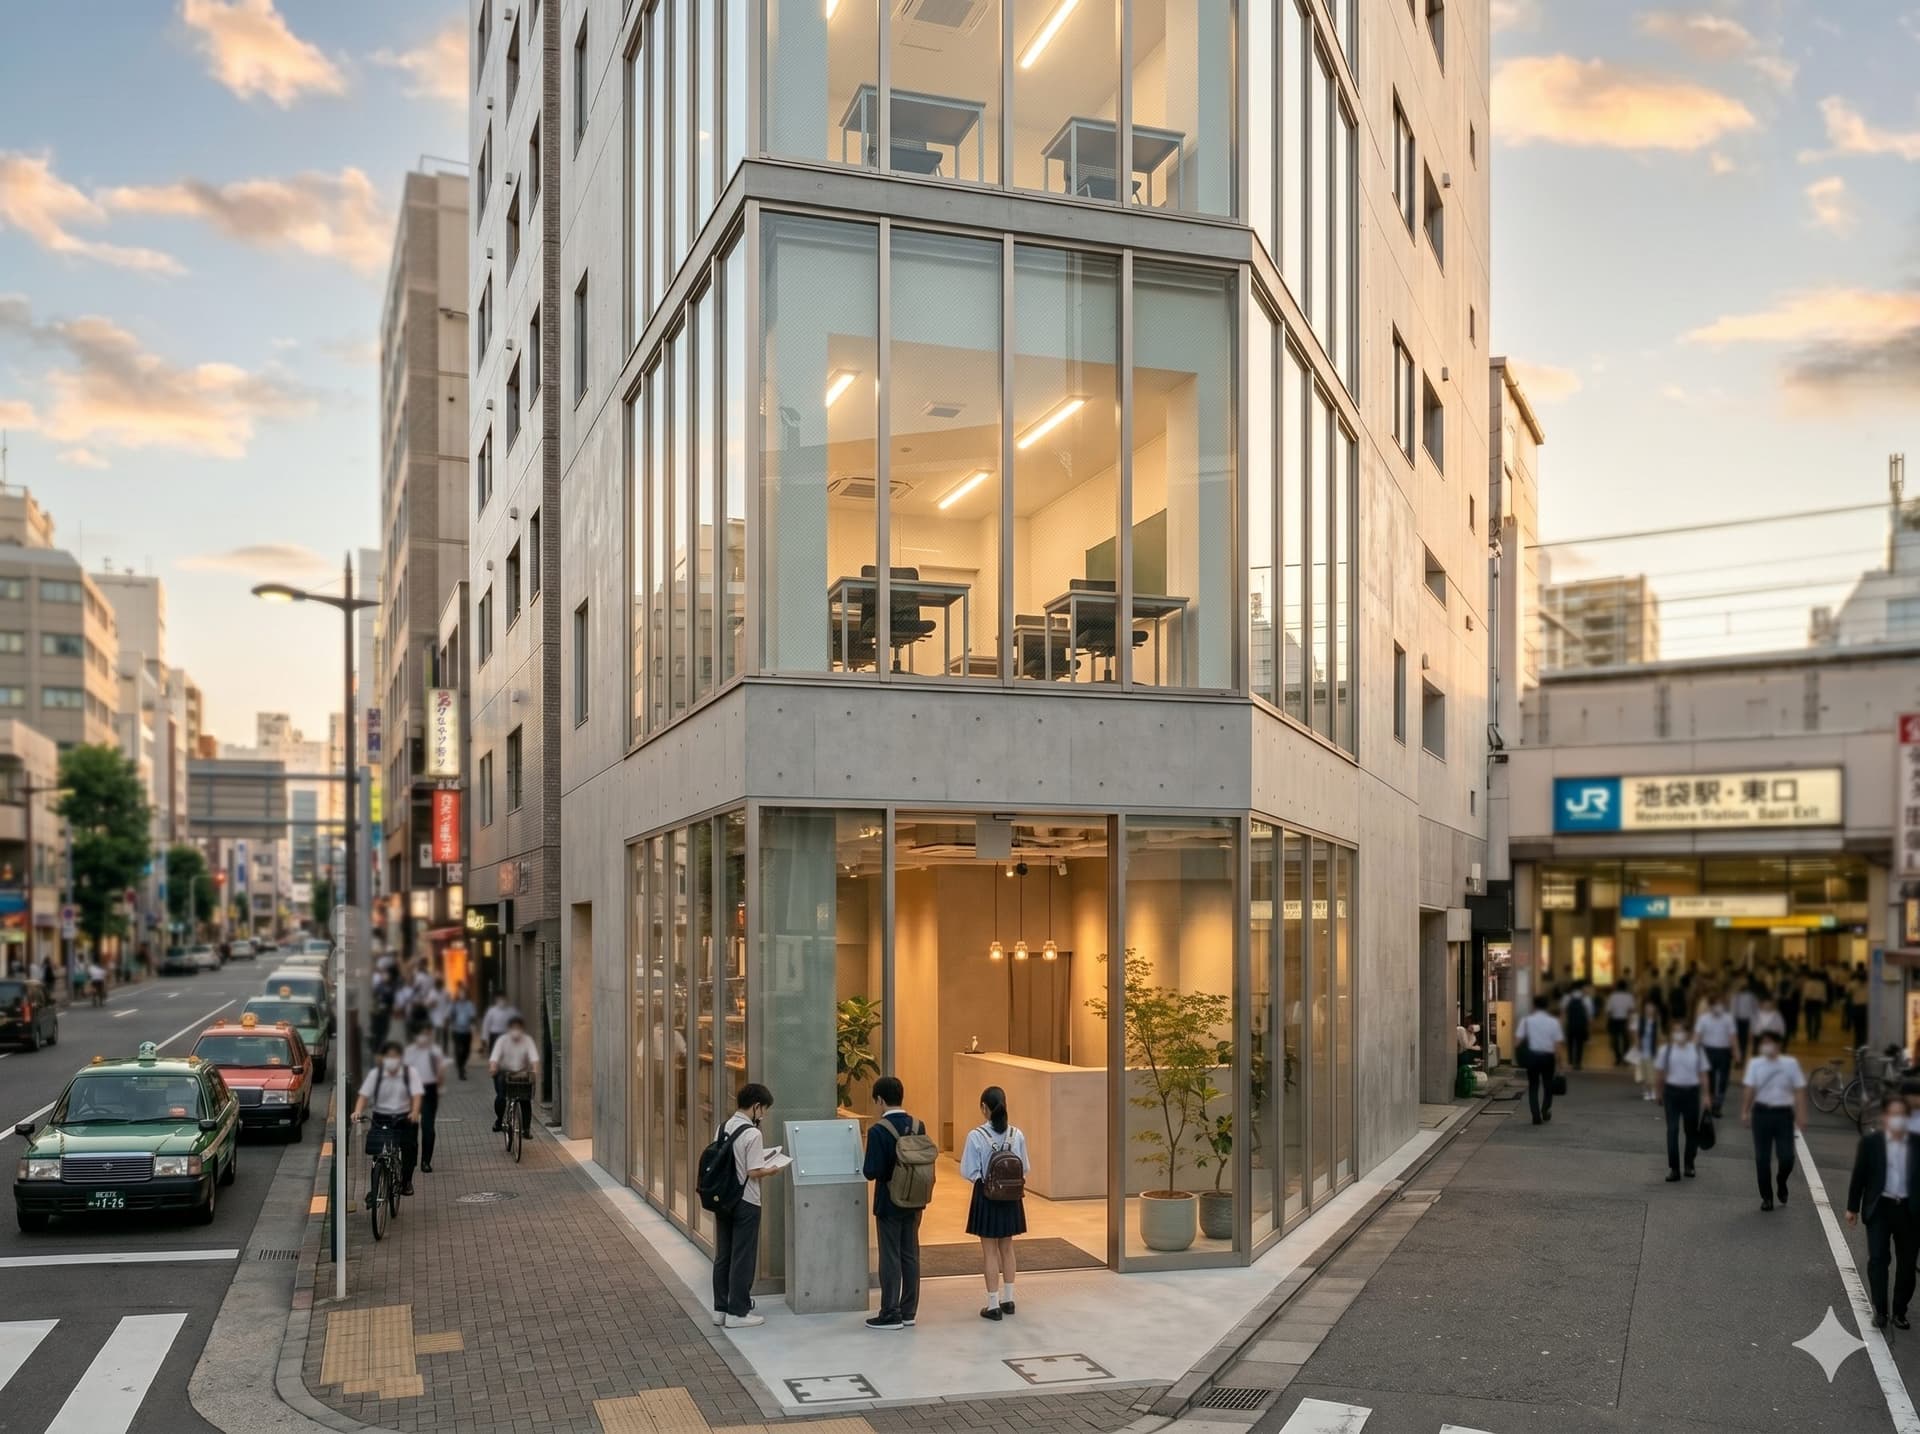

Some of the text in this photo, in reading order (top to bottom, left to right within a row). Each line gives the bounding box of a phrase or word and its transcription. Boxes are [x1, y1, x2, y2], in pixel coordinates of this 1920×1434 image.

[1566, 788, 1609, 813] JR
[1635, 779, 1798, 807] 池袋駅・東口
